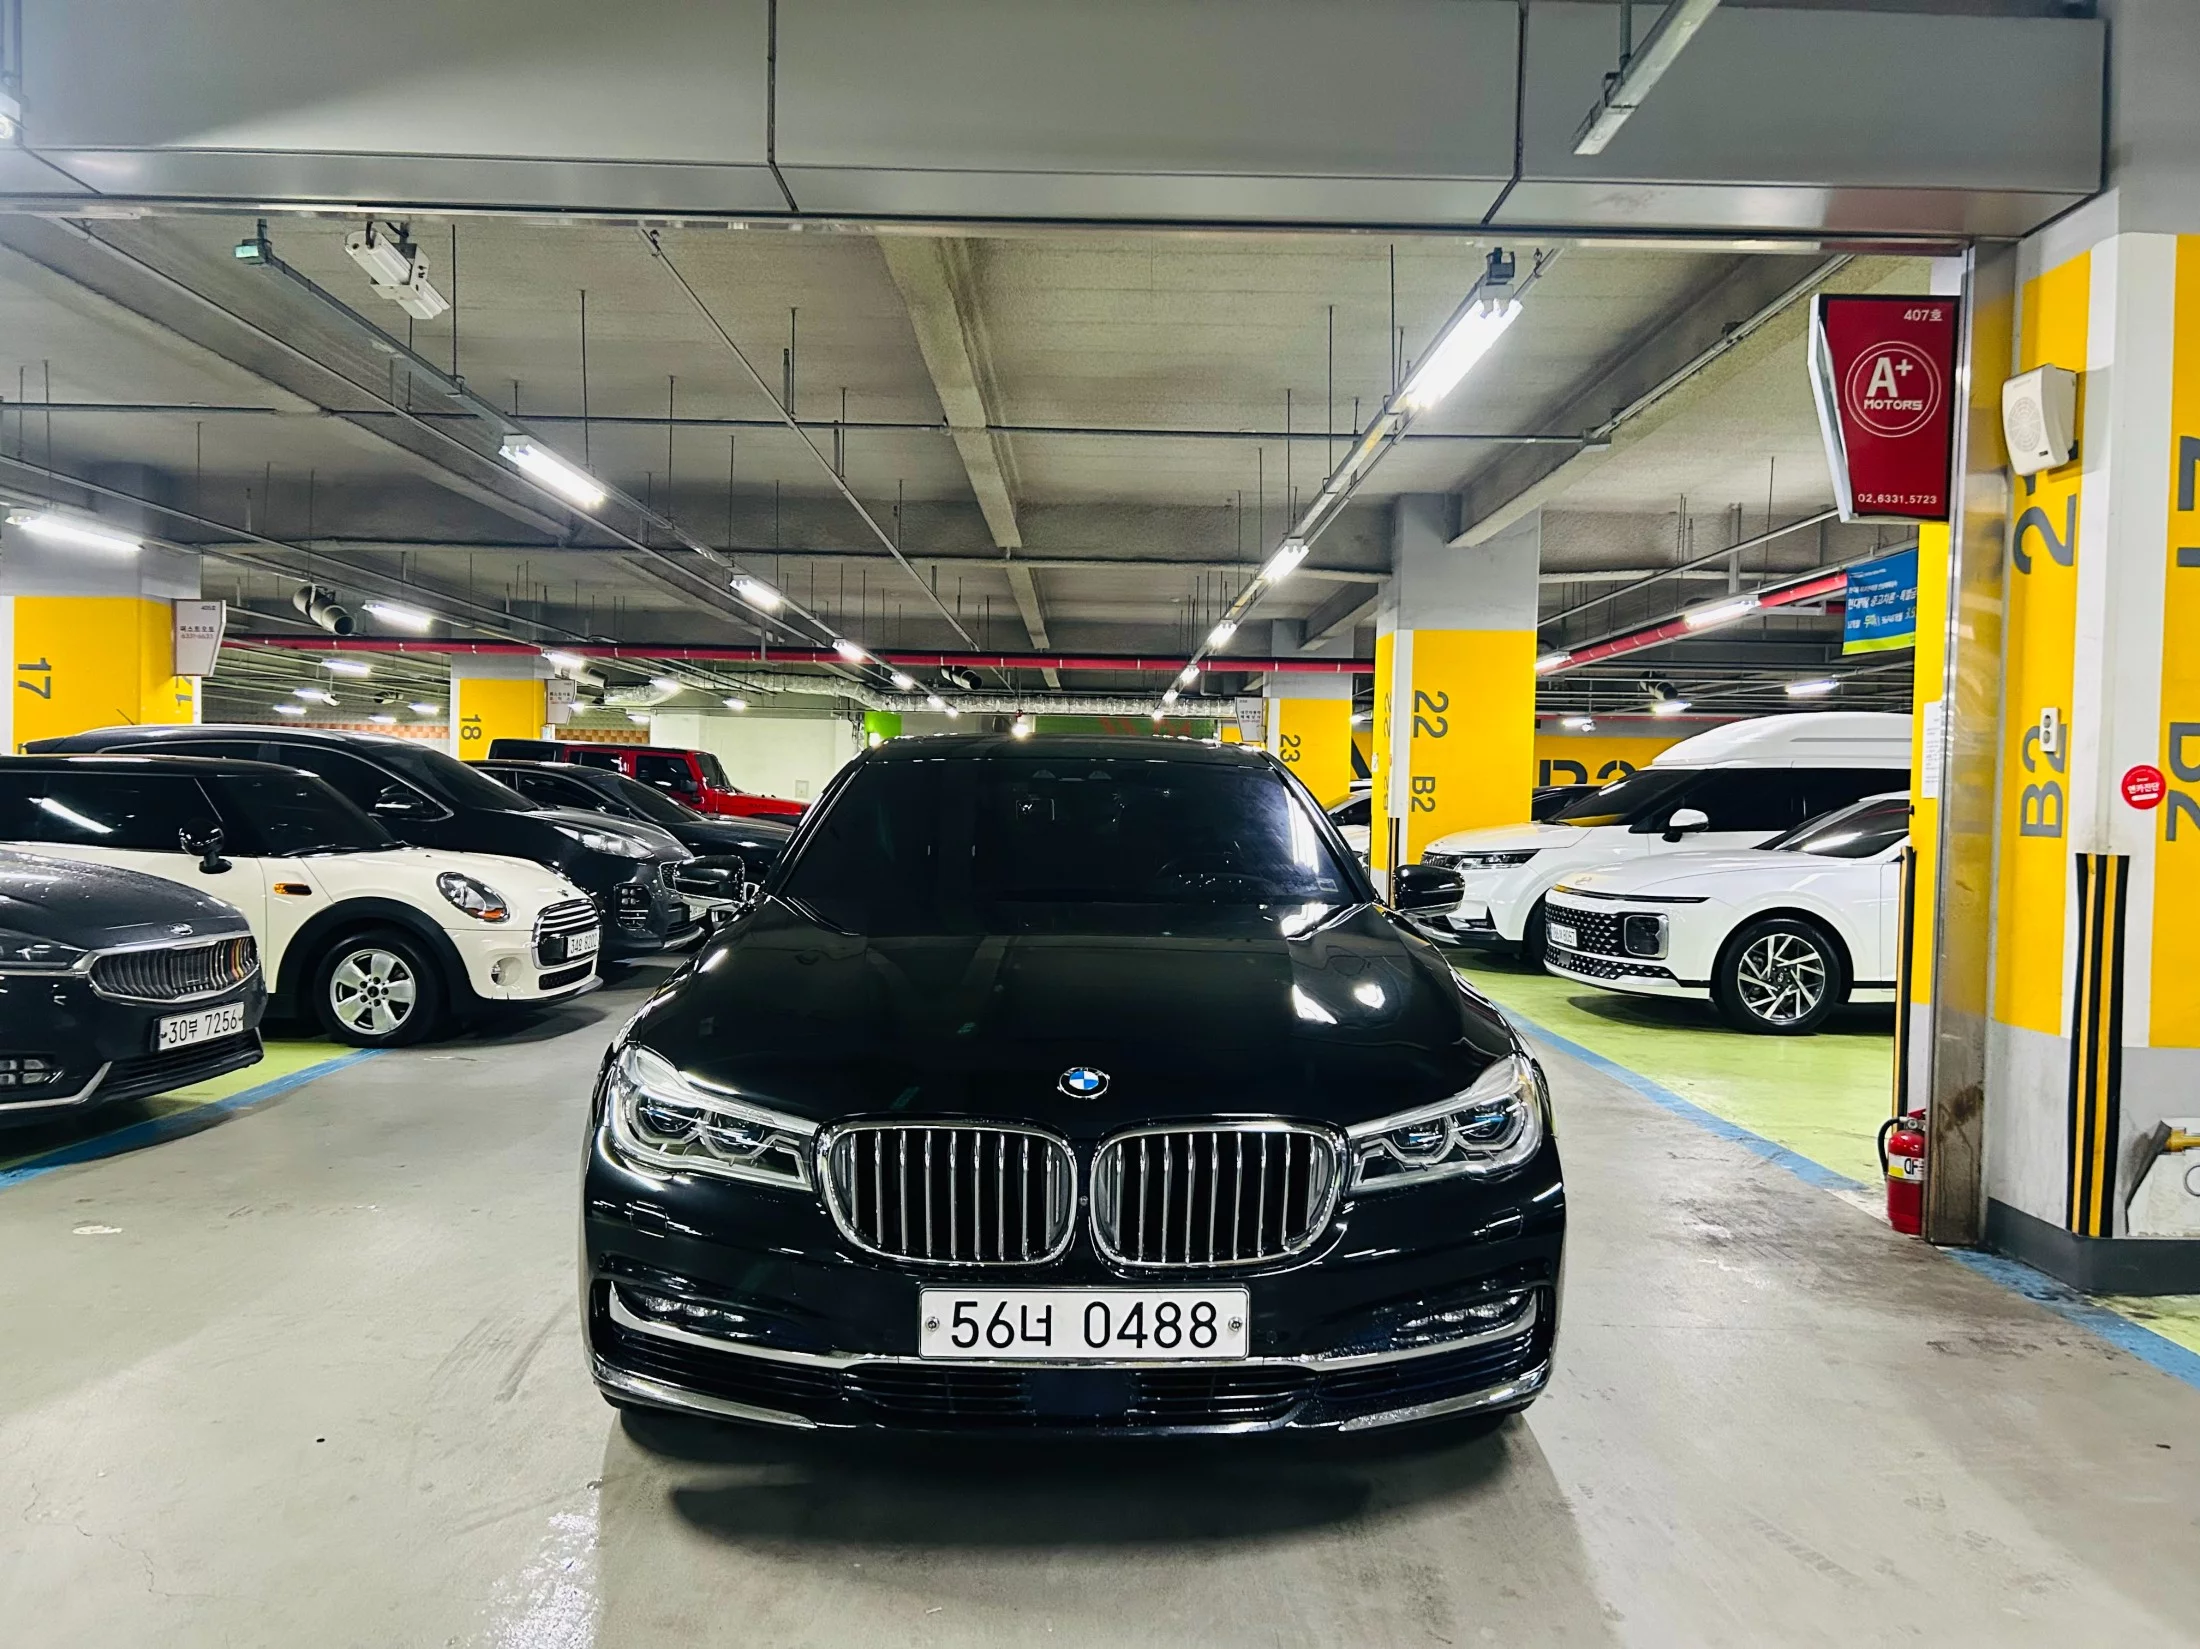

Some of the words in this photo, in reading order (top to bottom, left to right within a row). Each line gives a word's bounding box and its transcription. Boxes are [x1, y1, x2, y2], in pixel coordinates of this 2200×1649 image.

[1903, 308, 1944, 322] 407호
[1866, 356, 1914, 398] A+
[1863, 398, 1923, 411] MOTORS
[1857, 493, 1937, 505] 02.6331.5723
[18, 657, 51, 699] 17
[461, 714, 482, 740] 18
[1413, 690, 1449, 738] 22
[1279, 734, 1301, 762] 23
[1411, 776, 1436, 813] B2
[2020, 723, 2068, 838] B2
[168, 1018, 198, 1044] 30부
[205, 1009, 238, 1036] 7256
[951, 1300, 1053, 1349] 56너
[1083, 1300, 1218, 1349] 0488
